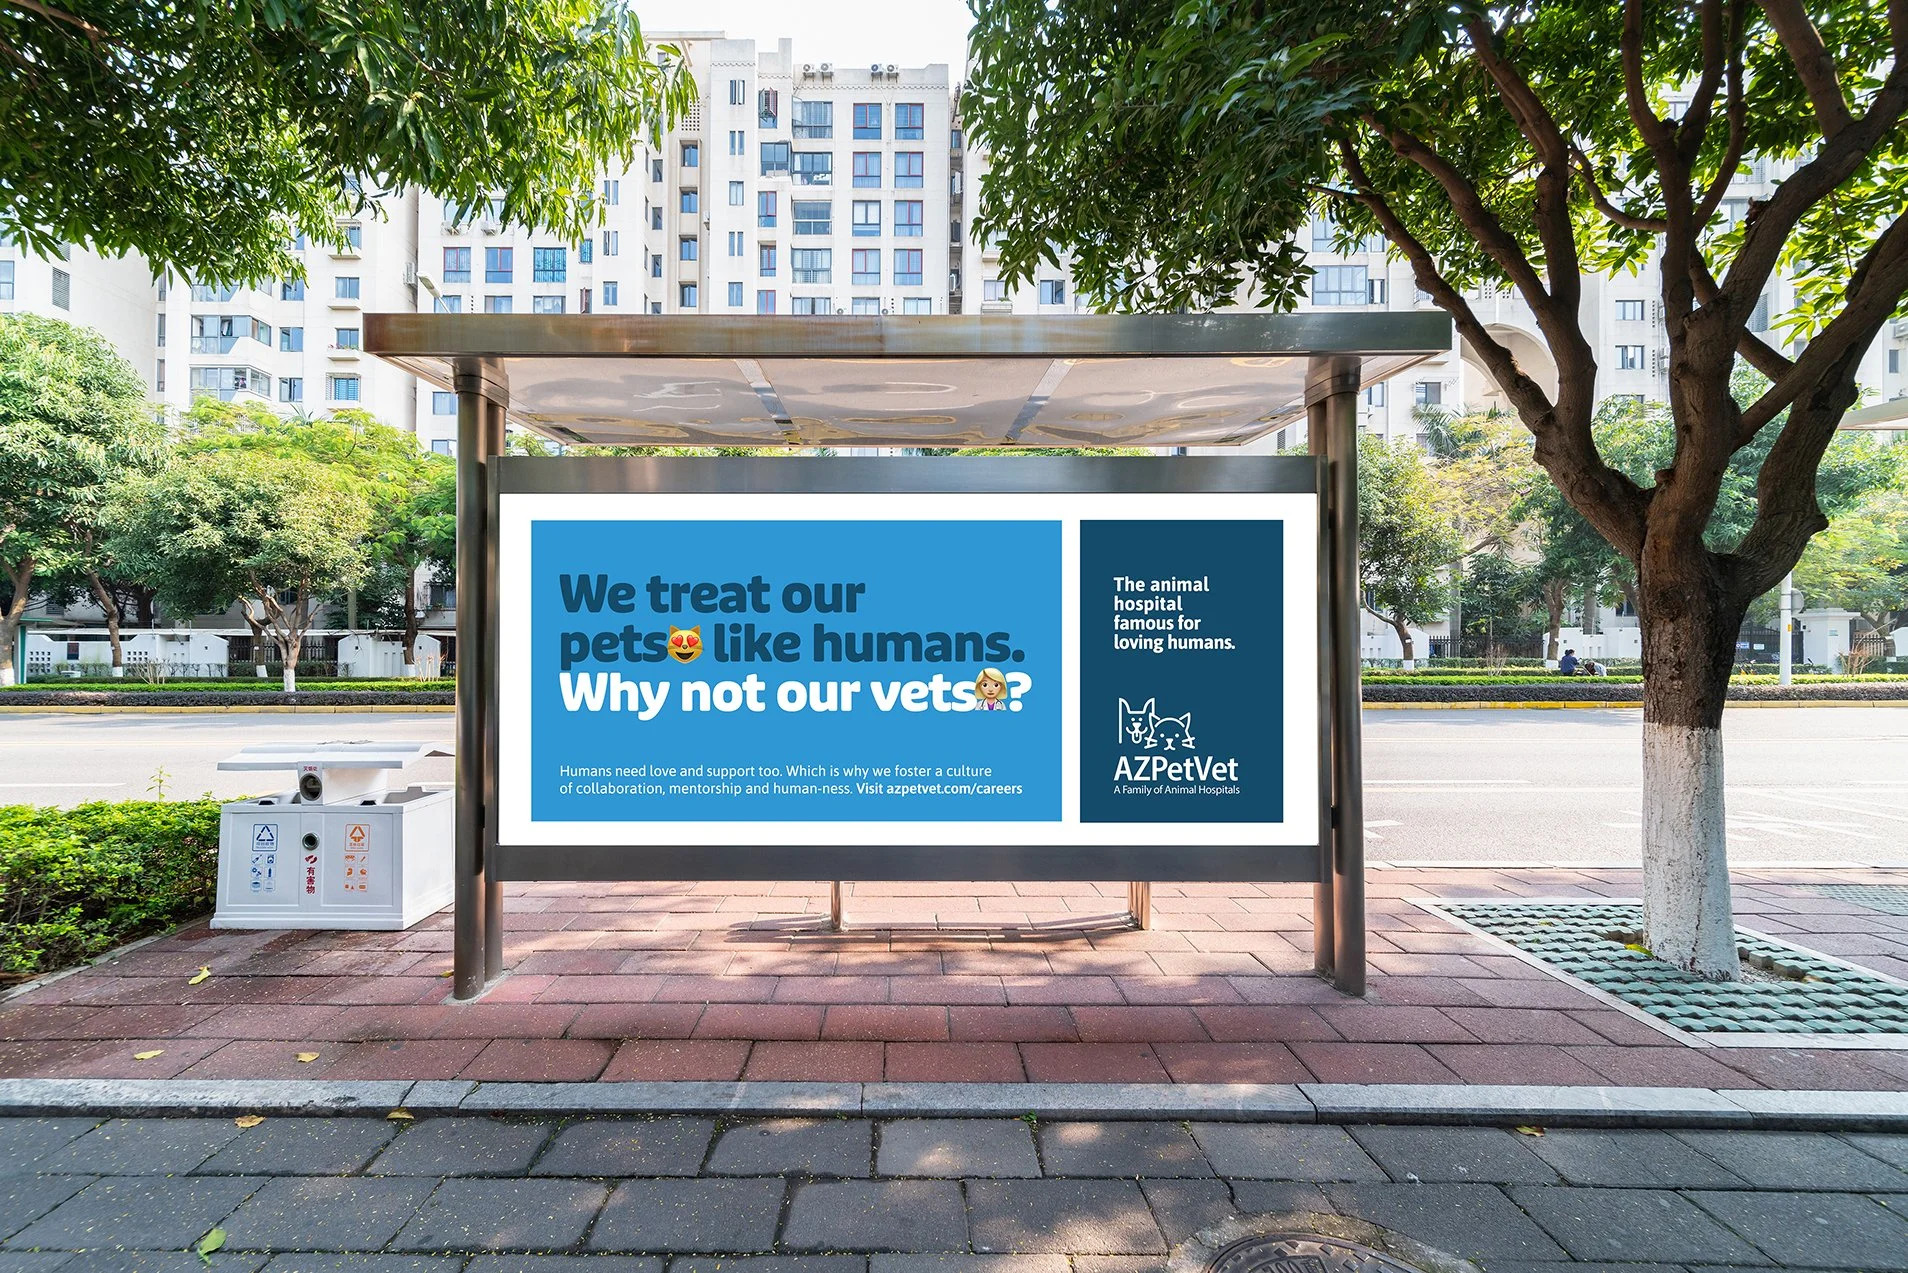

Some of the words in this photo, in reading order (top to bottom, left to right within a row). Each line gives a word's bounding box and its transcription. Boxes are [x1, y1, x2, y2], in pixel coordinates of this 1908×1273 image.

[559, 574, 636, 613] We
[646, 574, 770, 613] treat
[782, 582, 865, 613] our
[1113, 576, 1146, 592] The
[1150, 576, 1209, 592] animal
[1113, 595, 1183, 614] hospital
[1113, 614, 1174, 630] famous
[1178, 614, 1202, 630] for
[560, 625, 669, 670] pets
[714, 623, 801, 663] like
[814, 623, 1025, 663] humans.
[1113, 633, 1164, 654] loving
[1167, 633, 1236, 650] humans.
[559, 672, 671, 722] Why
[681, 674, 767, 713] not
[776, 680, 860, 713] our
[560, 765, 612, 777] Humans
[616, 765, 646, 777] need
[650, 765, 677, 777] love
[680, 765, 704, 777] and
[707, 767, 756, 780] support
[758, 766, 783, 777] too.
[785, 765, 826, 777] Which
[829, 765, 840, 777] is
[843, 765, 870, 780] why
[872, 767, 892, 777] we
[894, 765, 932, 777] foster
[935, 767, 943, 777] a
[946, 765, 992, 777] culture
[1113, 755, 1239, 782] AZPetVet
[559, 782, 573, 795] of
[575, 782, 666, 796] collaboration,
[669, 782, 742, 797] mentorship
[745, 782, 770, 795] and
[773, 782, 853, 795] human-ness.
[855, 782, 884, 795] Visit
[886, 783, 1023, 797] azpetvet.com/careers
[1113, 785, 1121, 795] A
[1122, 784, 1153, 797] Family
[1153, 784, 1164, 795] of
[1164, 784, 1197, 795] Animal
[1198, 784, 1241, 797] Hospitals
[305, 866, 316, 895] 有害物
